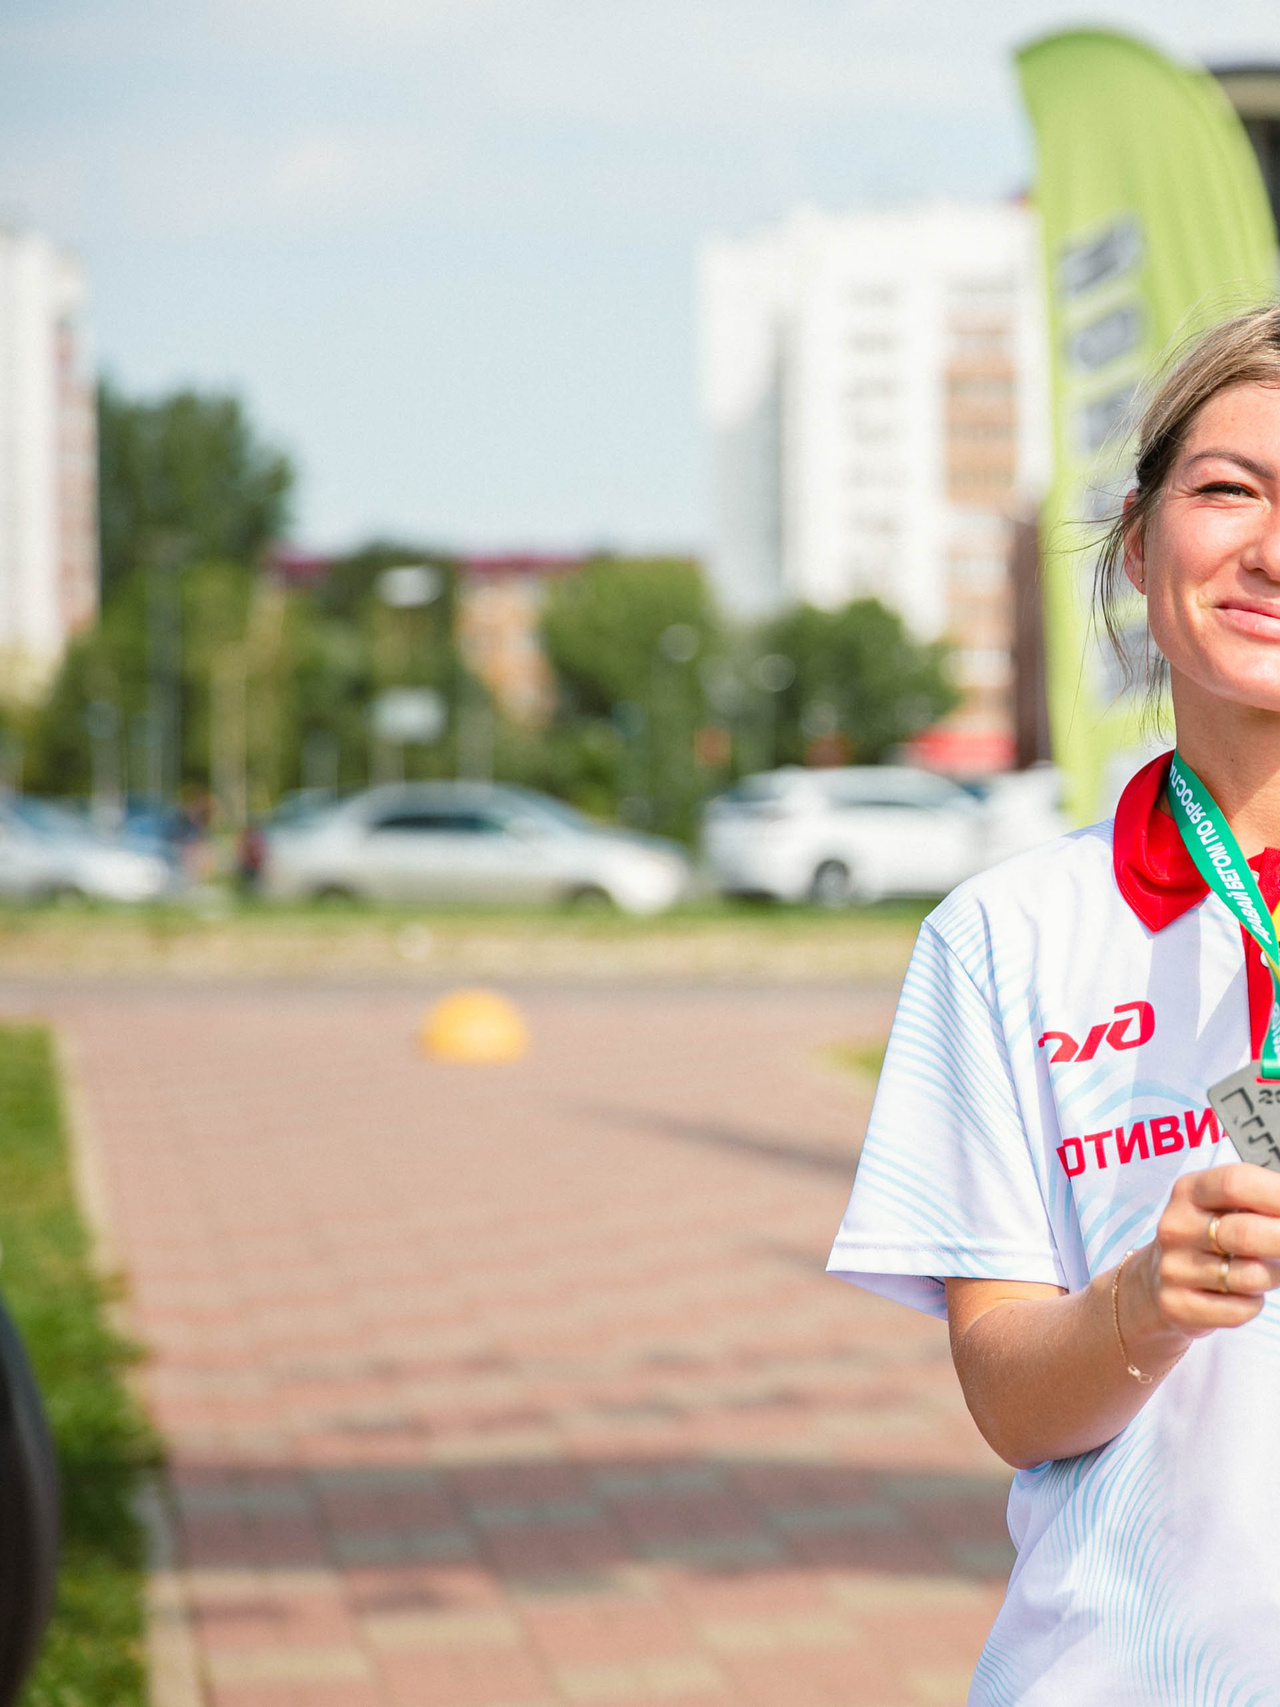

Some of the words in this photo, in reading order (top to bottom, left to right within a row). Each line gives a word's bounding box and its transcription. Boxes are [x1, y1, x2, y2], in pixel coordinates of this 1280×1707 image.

[1196, 821, 1217, 846] ПО
[1206, 839, 1246, 894] БЕГОМ
[1056, 1106, 1229, 1180] ОТИВИ
